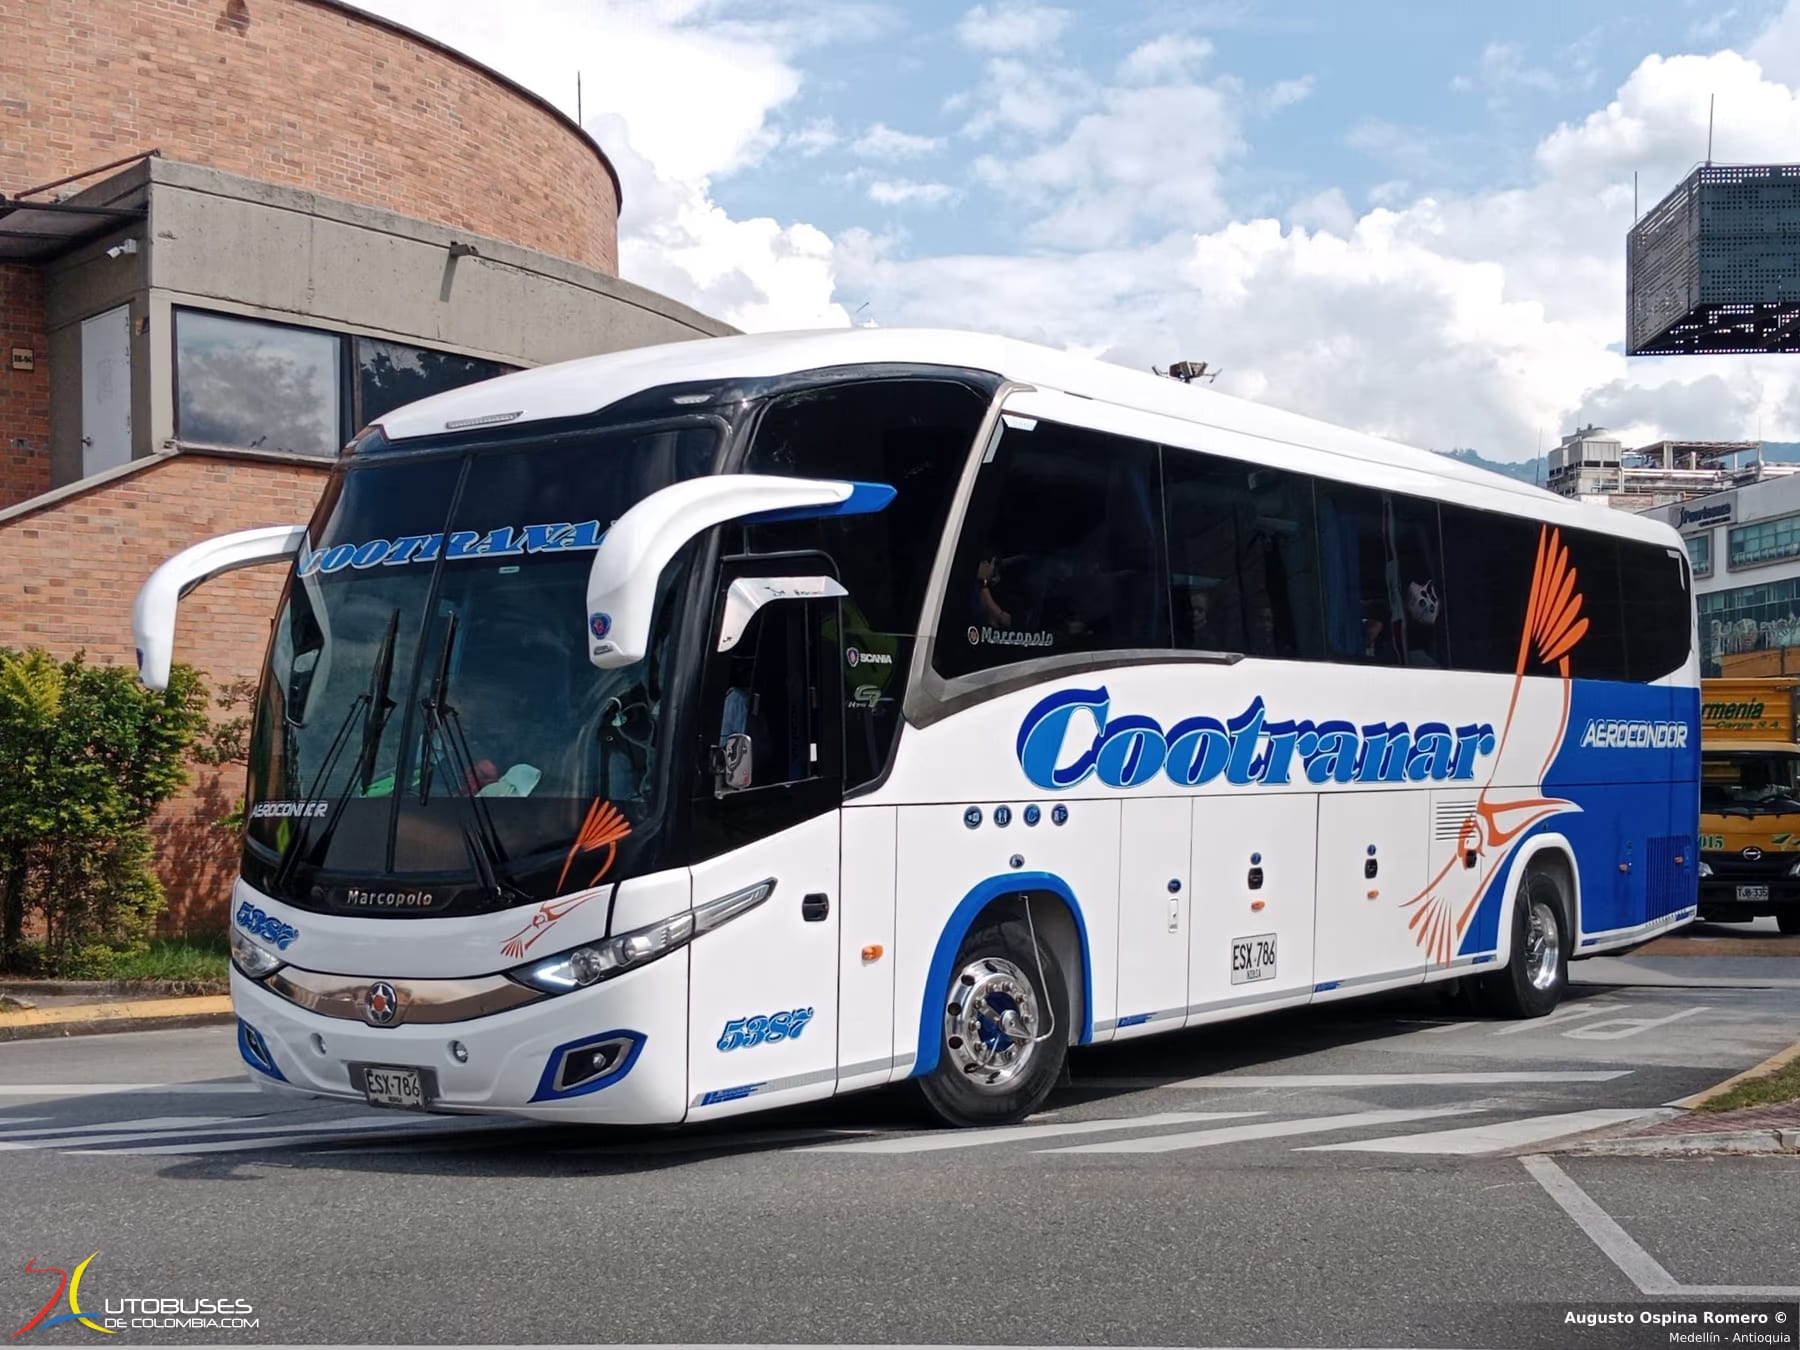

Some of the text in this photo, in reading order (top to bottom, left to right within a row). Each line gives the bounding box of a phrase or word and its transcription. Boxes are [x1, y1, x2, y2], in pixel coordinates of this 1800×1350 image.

[297, 520, 617, 577] COOTRANA
[981, 626, 1053, 647] Marcopolo
[860, 653, 892, 664] SCANIA
[1702, 697, 1764, 720] rmenia
[1016, 685, 1496, 790] Cootranar
[1580, 718, 1688, 748] AEROCONDOR
[347, 889, 433, 907] Marcopolo
[235, 900, 299, 951] 5387
[716, 1006, 814, 1052] 5387
